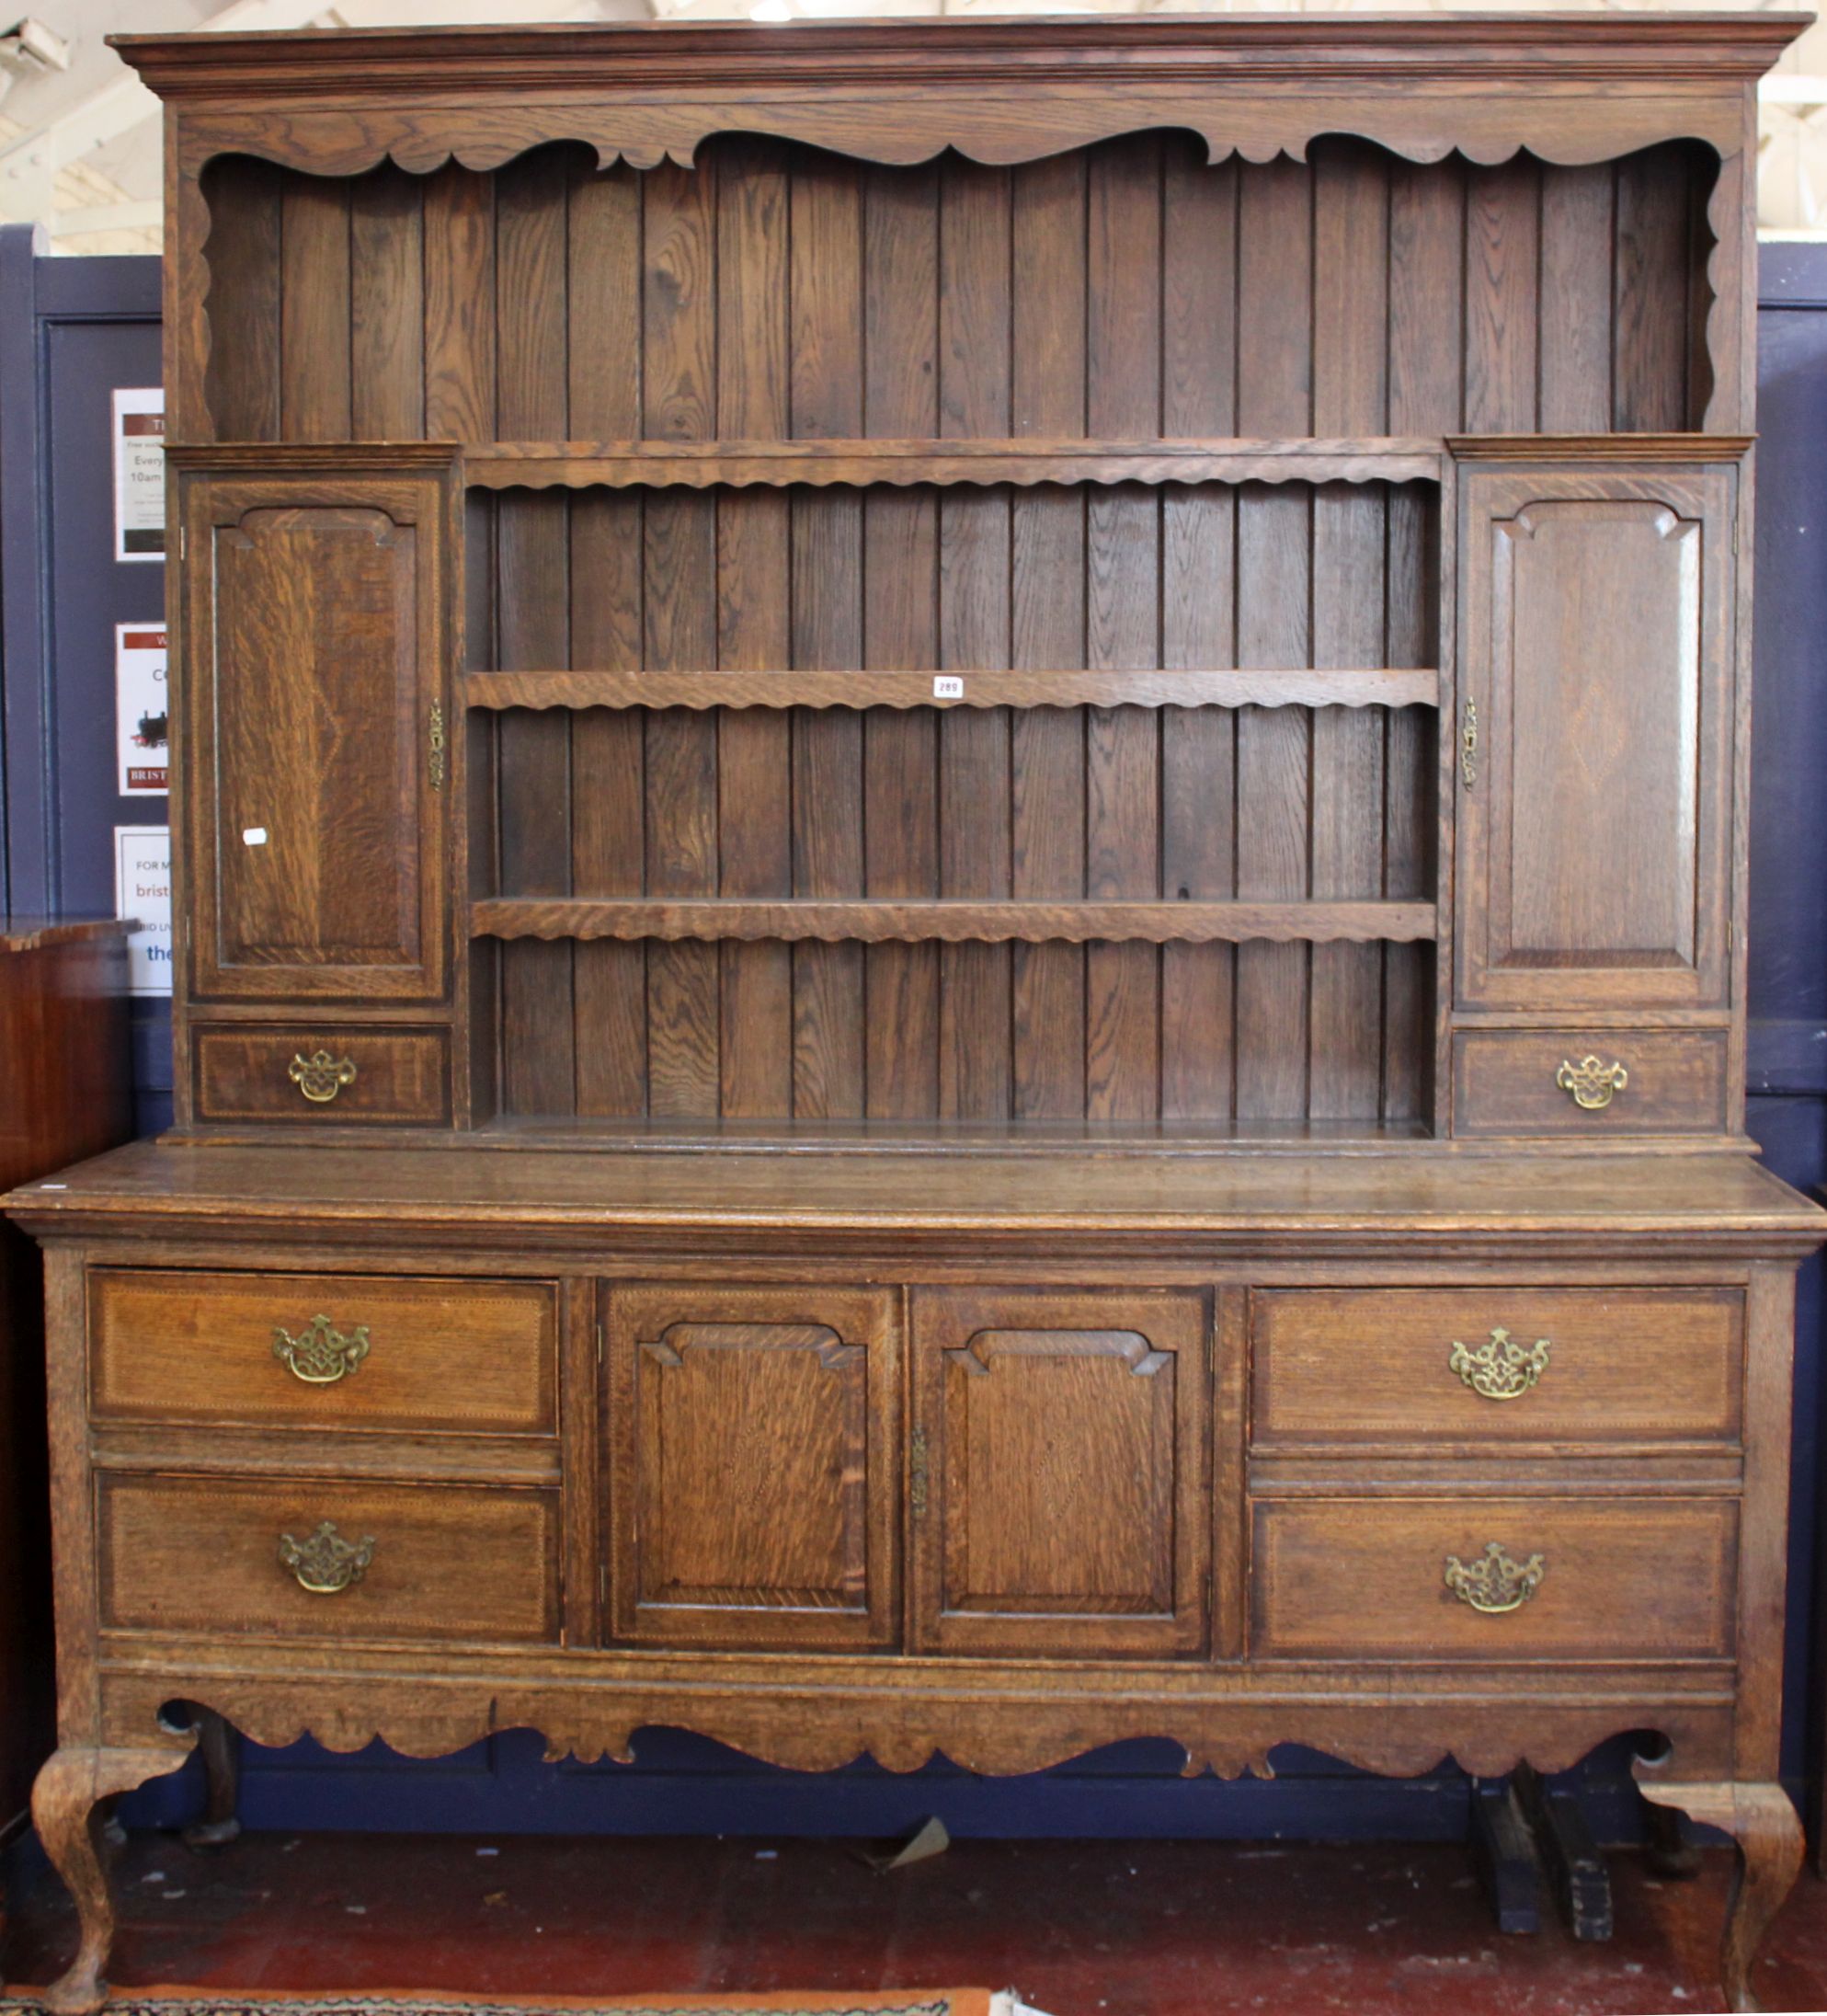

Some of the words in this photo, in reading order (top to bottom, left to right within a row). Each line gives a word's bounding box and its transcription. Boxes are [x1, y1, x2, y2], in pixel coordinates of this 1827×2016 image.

[134, 455, 163, 467] Every
[131, 472, 161, 483] 10am
[939, 682, 957, 692] 289
[136, 861, 158, 870] FOR
[136, 883, 168, 897] brist
